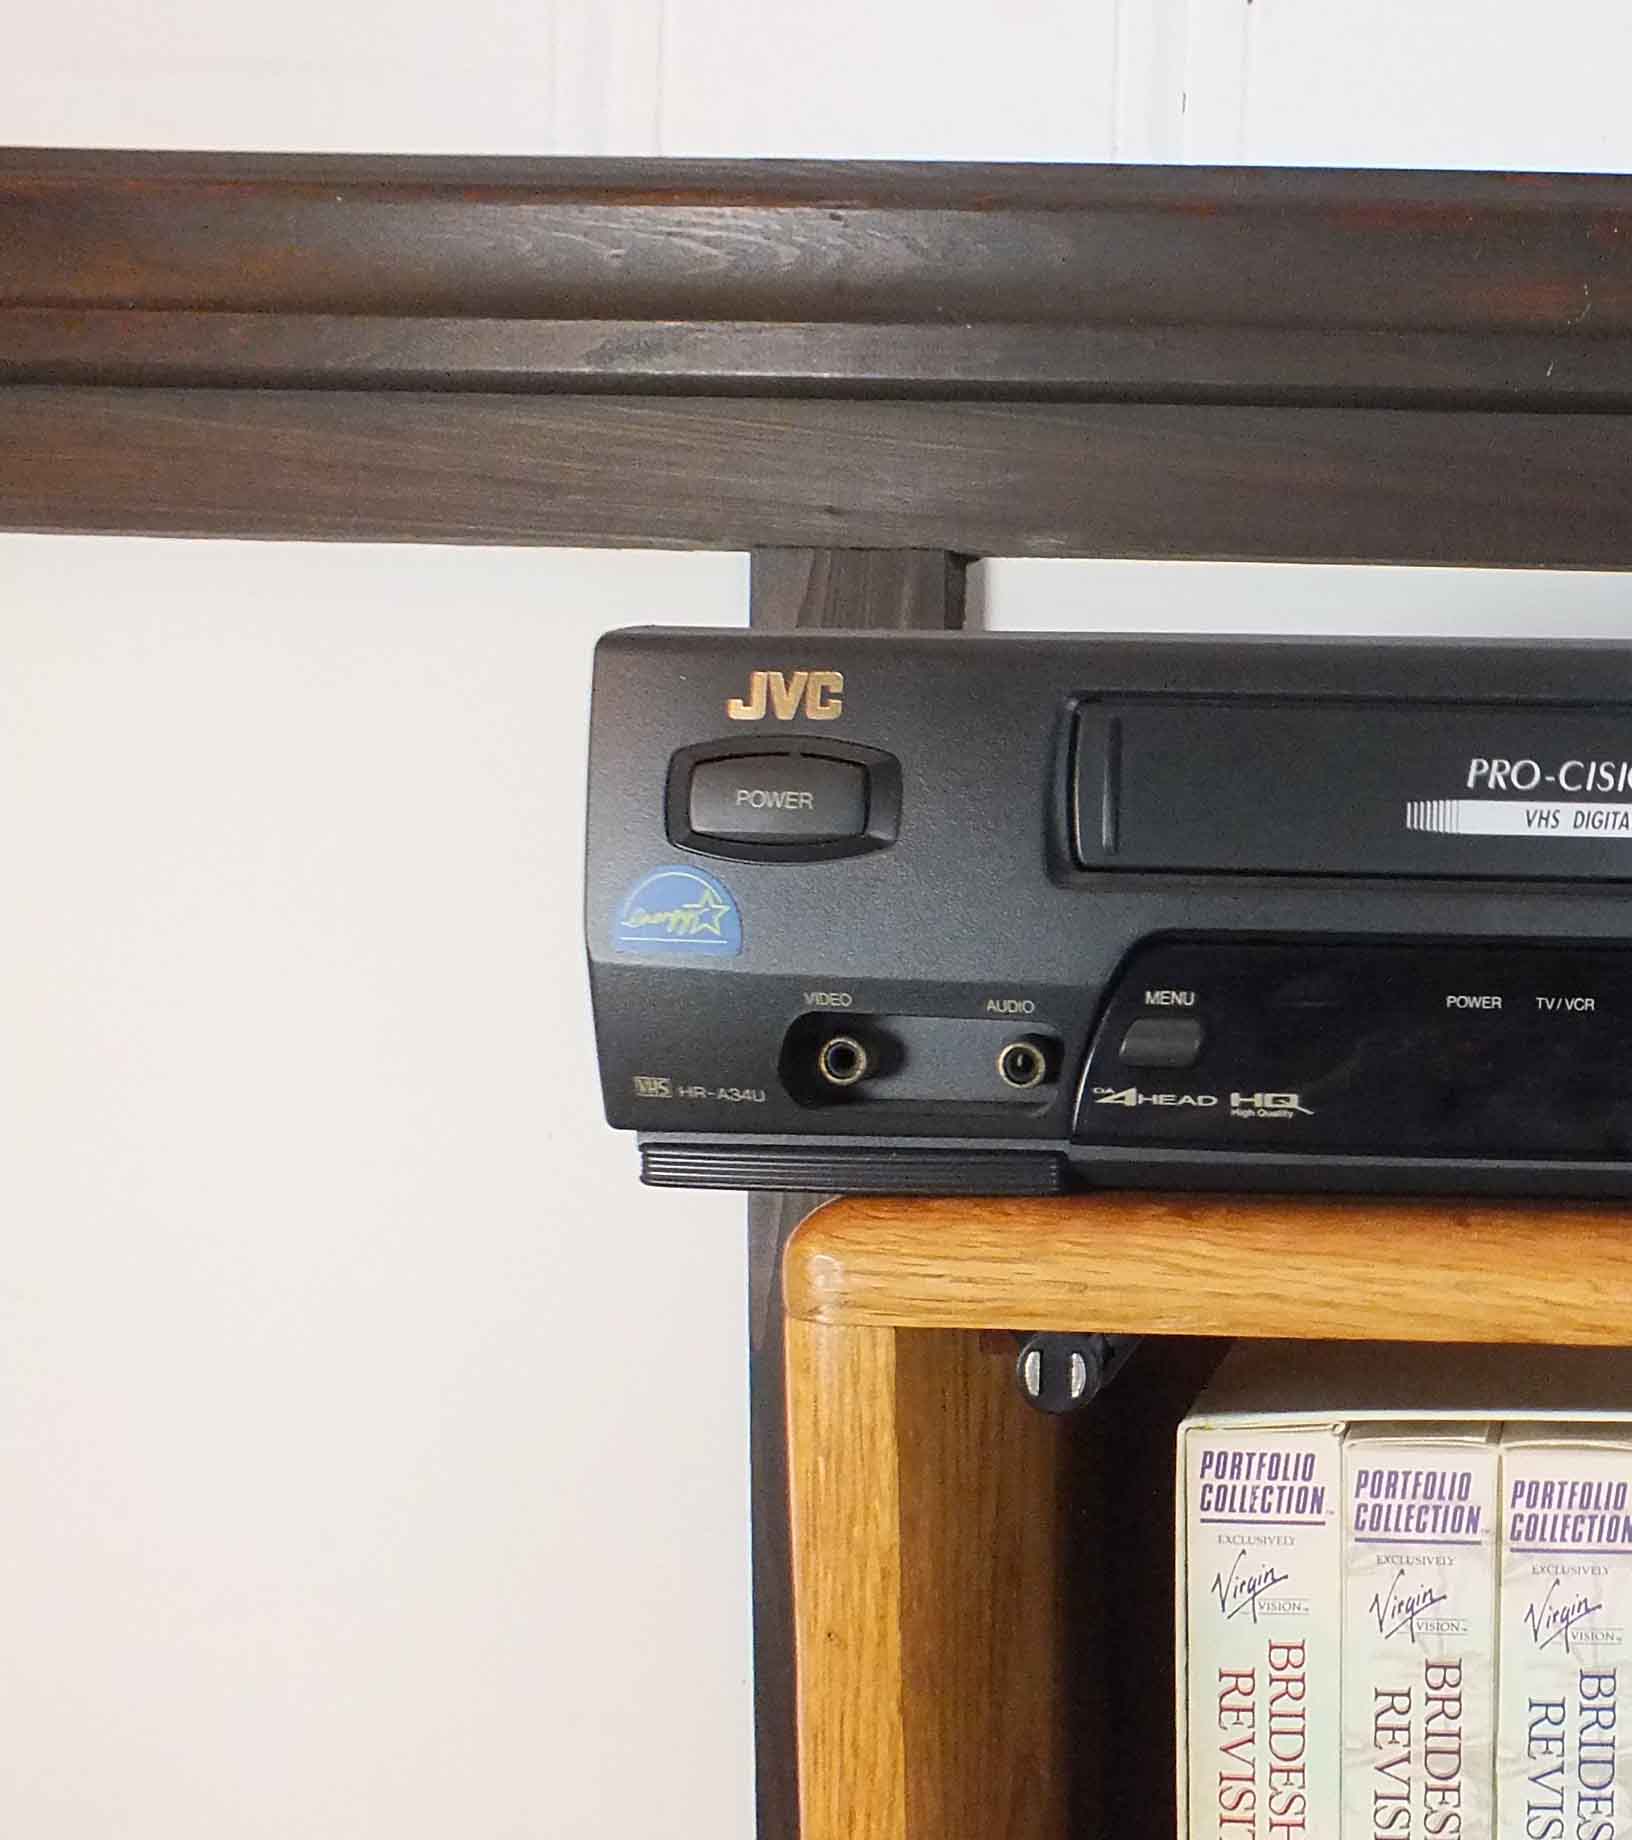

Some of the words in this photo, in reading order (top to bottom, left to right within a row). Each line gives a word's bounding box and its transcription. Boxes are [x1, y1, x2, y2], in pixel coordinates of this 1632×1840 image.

[726, 671, 844, 721] JVC
[735, 788, 814, 811] POWER
[1524, 808, 1561, 829] VHS
[803, 992, 853, 1007] VIDEO
[986, 999, 1036, 1014] AUDIO
[1145, 990, 1196, 1006] MENU
[1446, 995, 1503, 1010] POWER
[1230, 1092, 1314, 1115] HQ
[1231, 1108, 1255, 1118] High
[1257, 1108, 1294, 1119] Quality
[1199, 1450, 1317, 1482] PORTFOLIO
[1354, 1470, 1472, 1502] PORTFOLIO
[1510, 1479, 1628, 1511] PORTFOLIO
[1217, 1534, 1297, 1546] EXCLUSIVELY
[1376, 1554, 1457, 1567] EXCLUSIVELY
[1531, 1564, 1610, 1576] EXCLUSIVELY
[1211, 1549, 1288, 1624] Virgin
[1369, 1568, 1447, 1644] Virgin
[1524, 1578, 1602, 1653] Virgin
